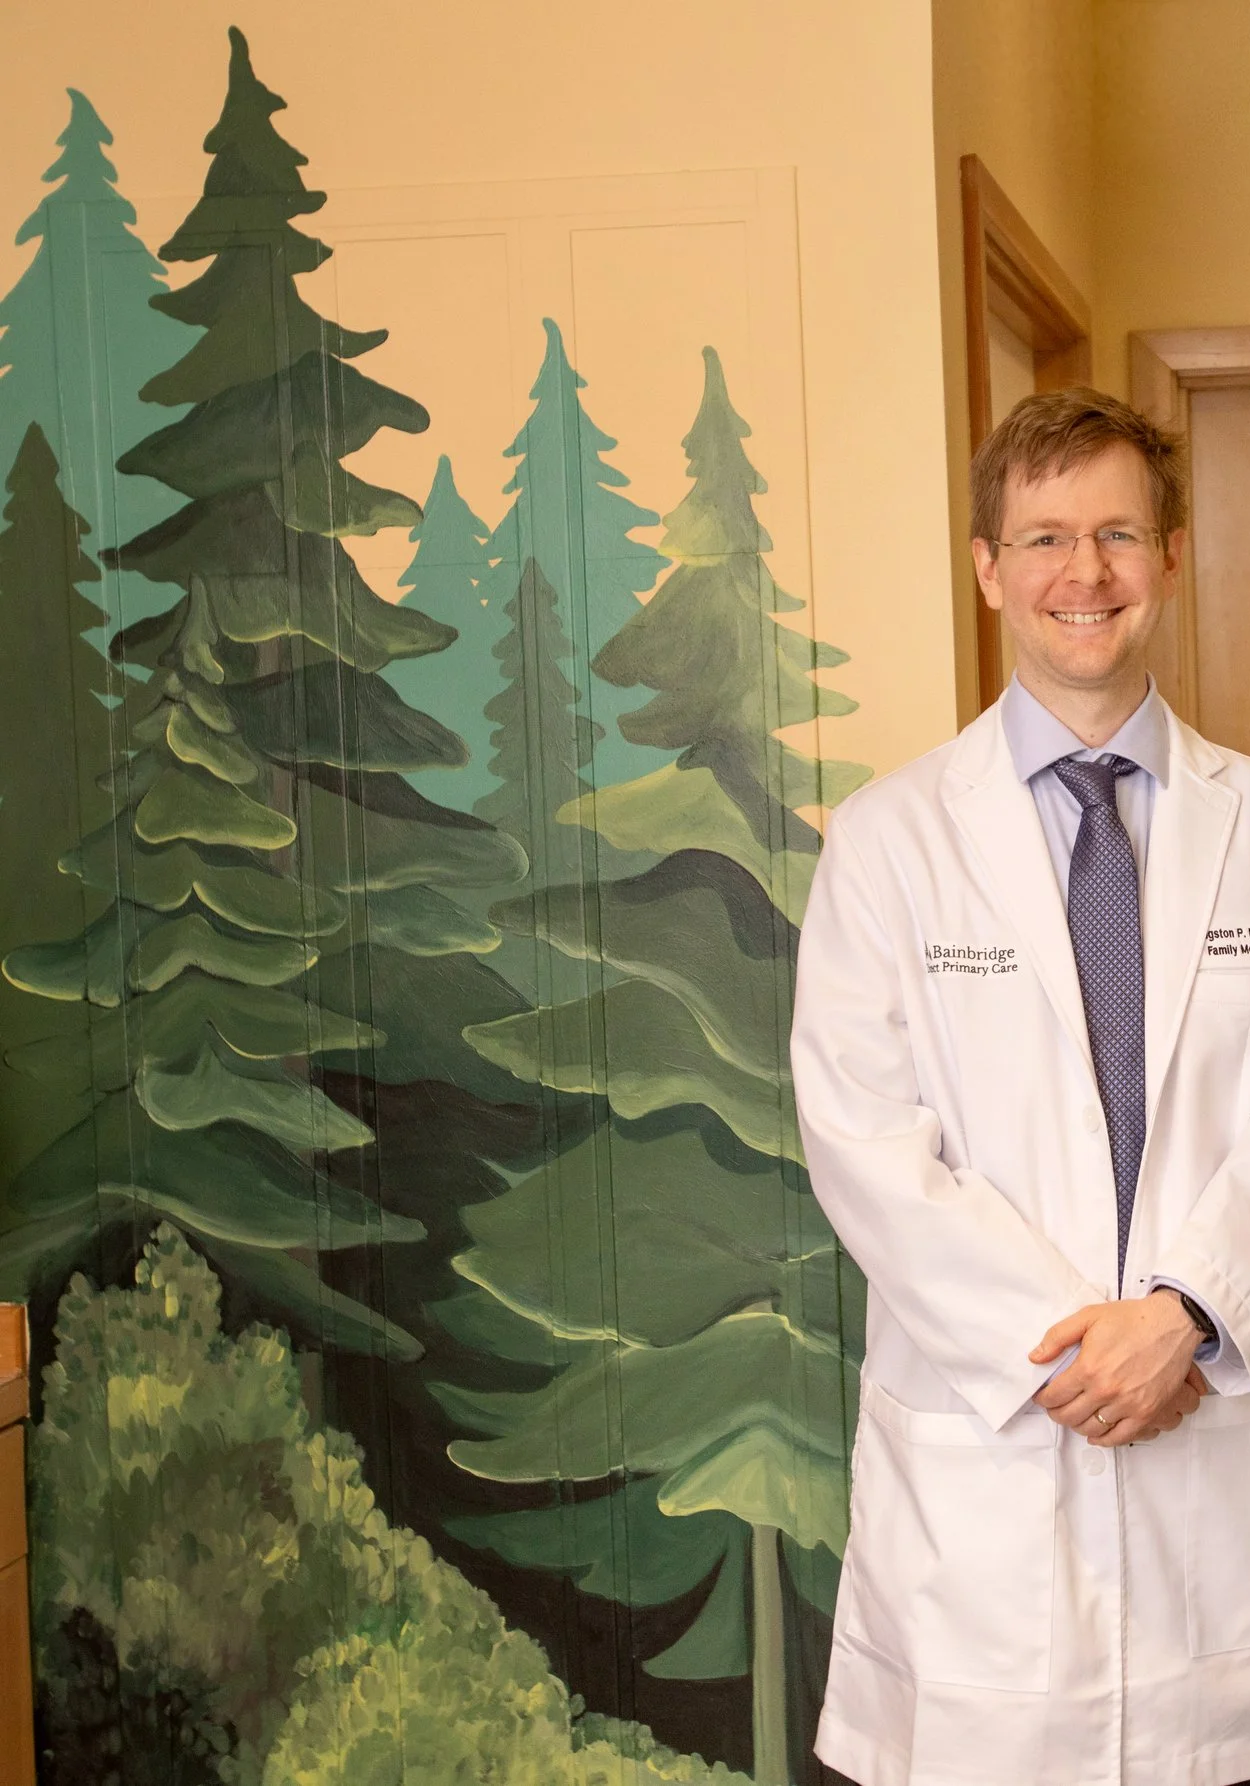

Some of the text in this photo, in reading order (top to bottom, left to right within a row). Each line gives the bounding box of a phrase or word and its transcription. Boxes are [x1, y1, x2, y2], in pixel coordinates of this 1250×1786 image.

[1206, 928, 1235, 941] gston
[1236, 928, 1246, 938] P.
[932, 945, 1015, 963] Bainbridge
[1207, 944, 1238, 956] Family
[942, 961, 989, 977] Primary
[991, 963, 1018, 974] Care
